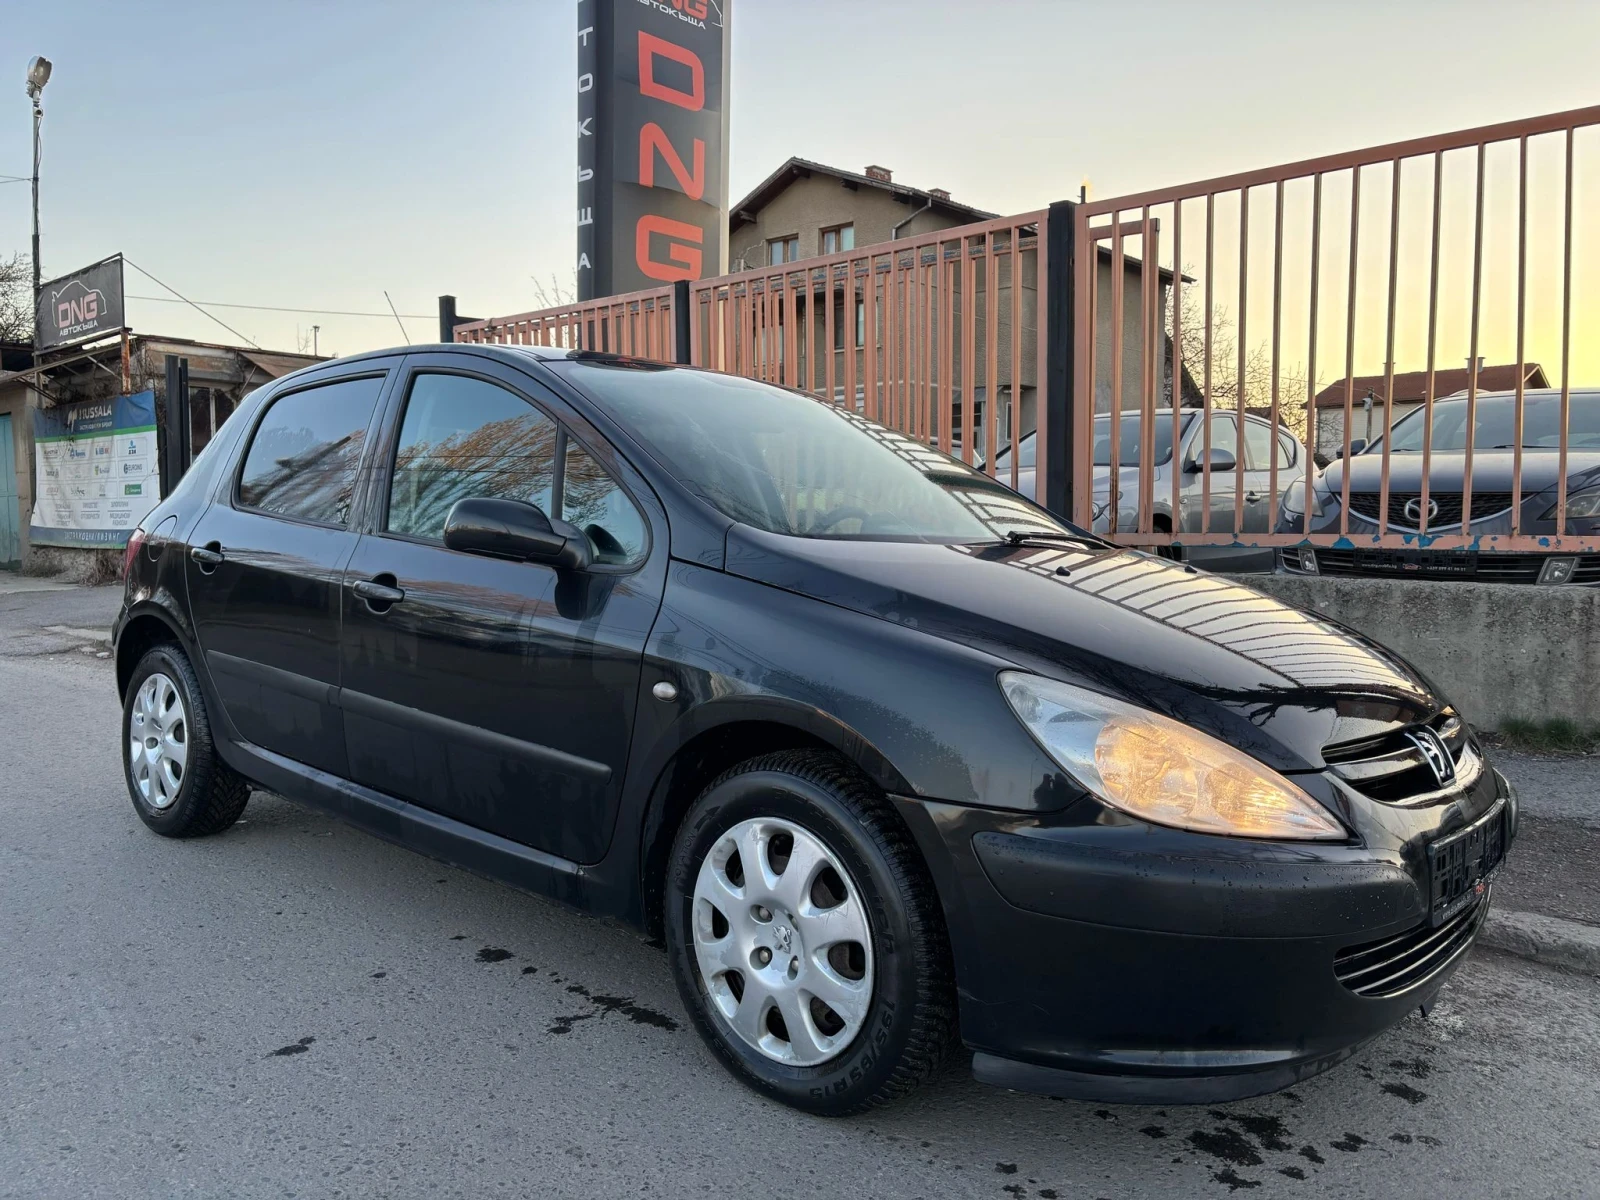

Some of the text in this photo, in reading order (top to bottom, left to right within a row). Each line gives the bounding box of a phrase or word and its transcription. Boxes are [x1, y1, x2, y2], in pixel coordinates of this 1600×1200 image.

[637, 0, 706, 30] ВТОКЪЩА
[635, 30, 705, 283] DNG
[58, 292, 98, 328] DNG
[59, 319, 99, 337] АВТОКЪЩА
